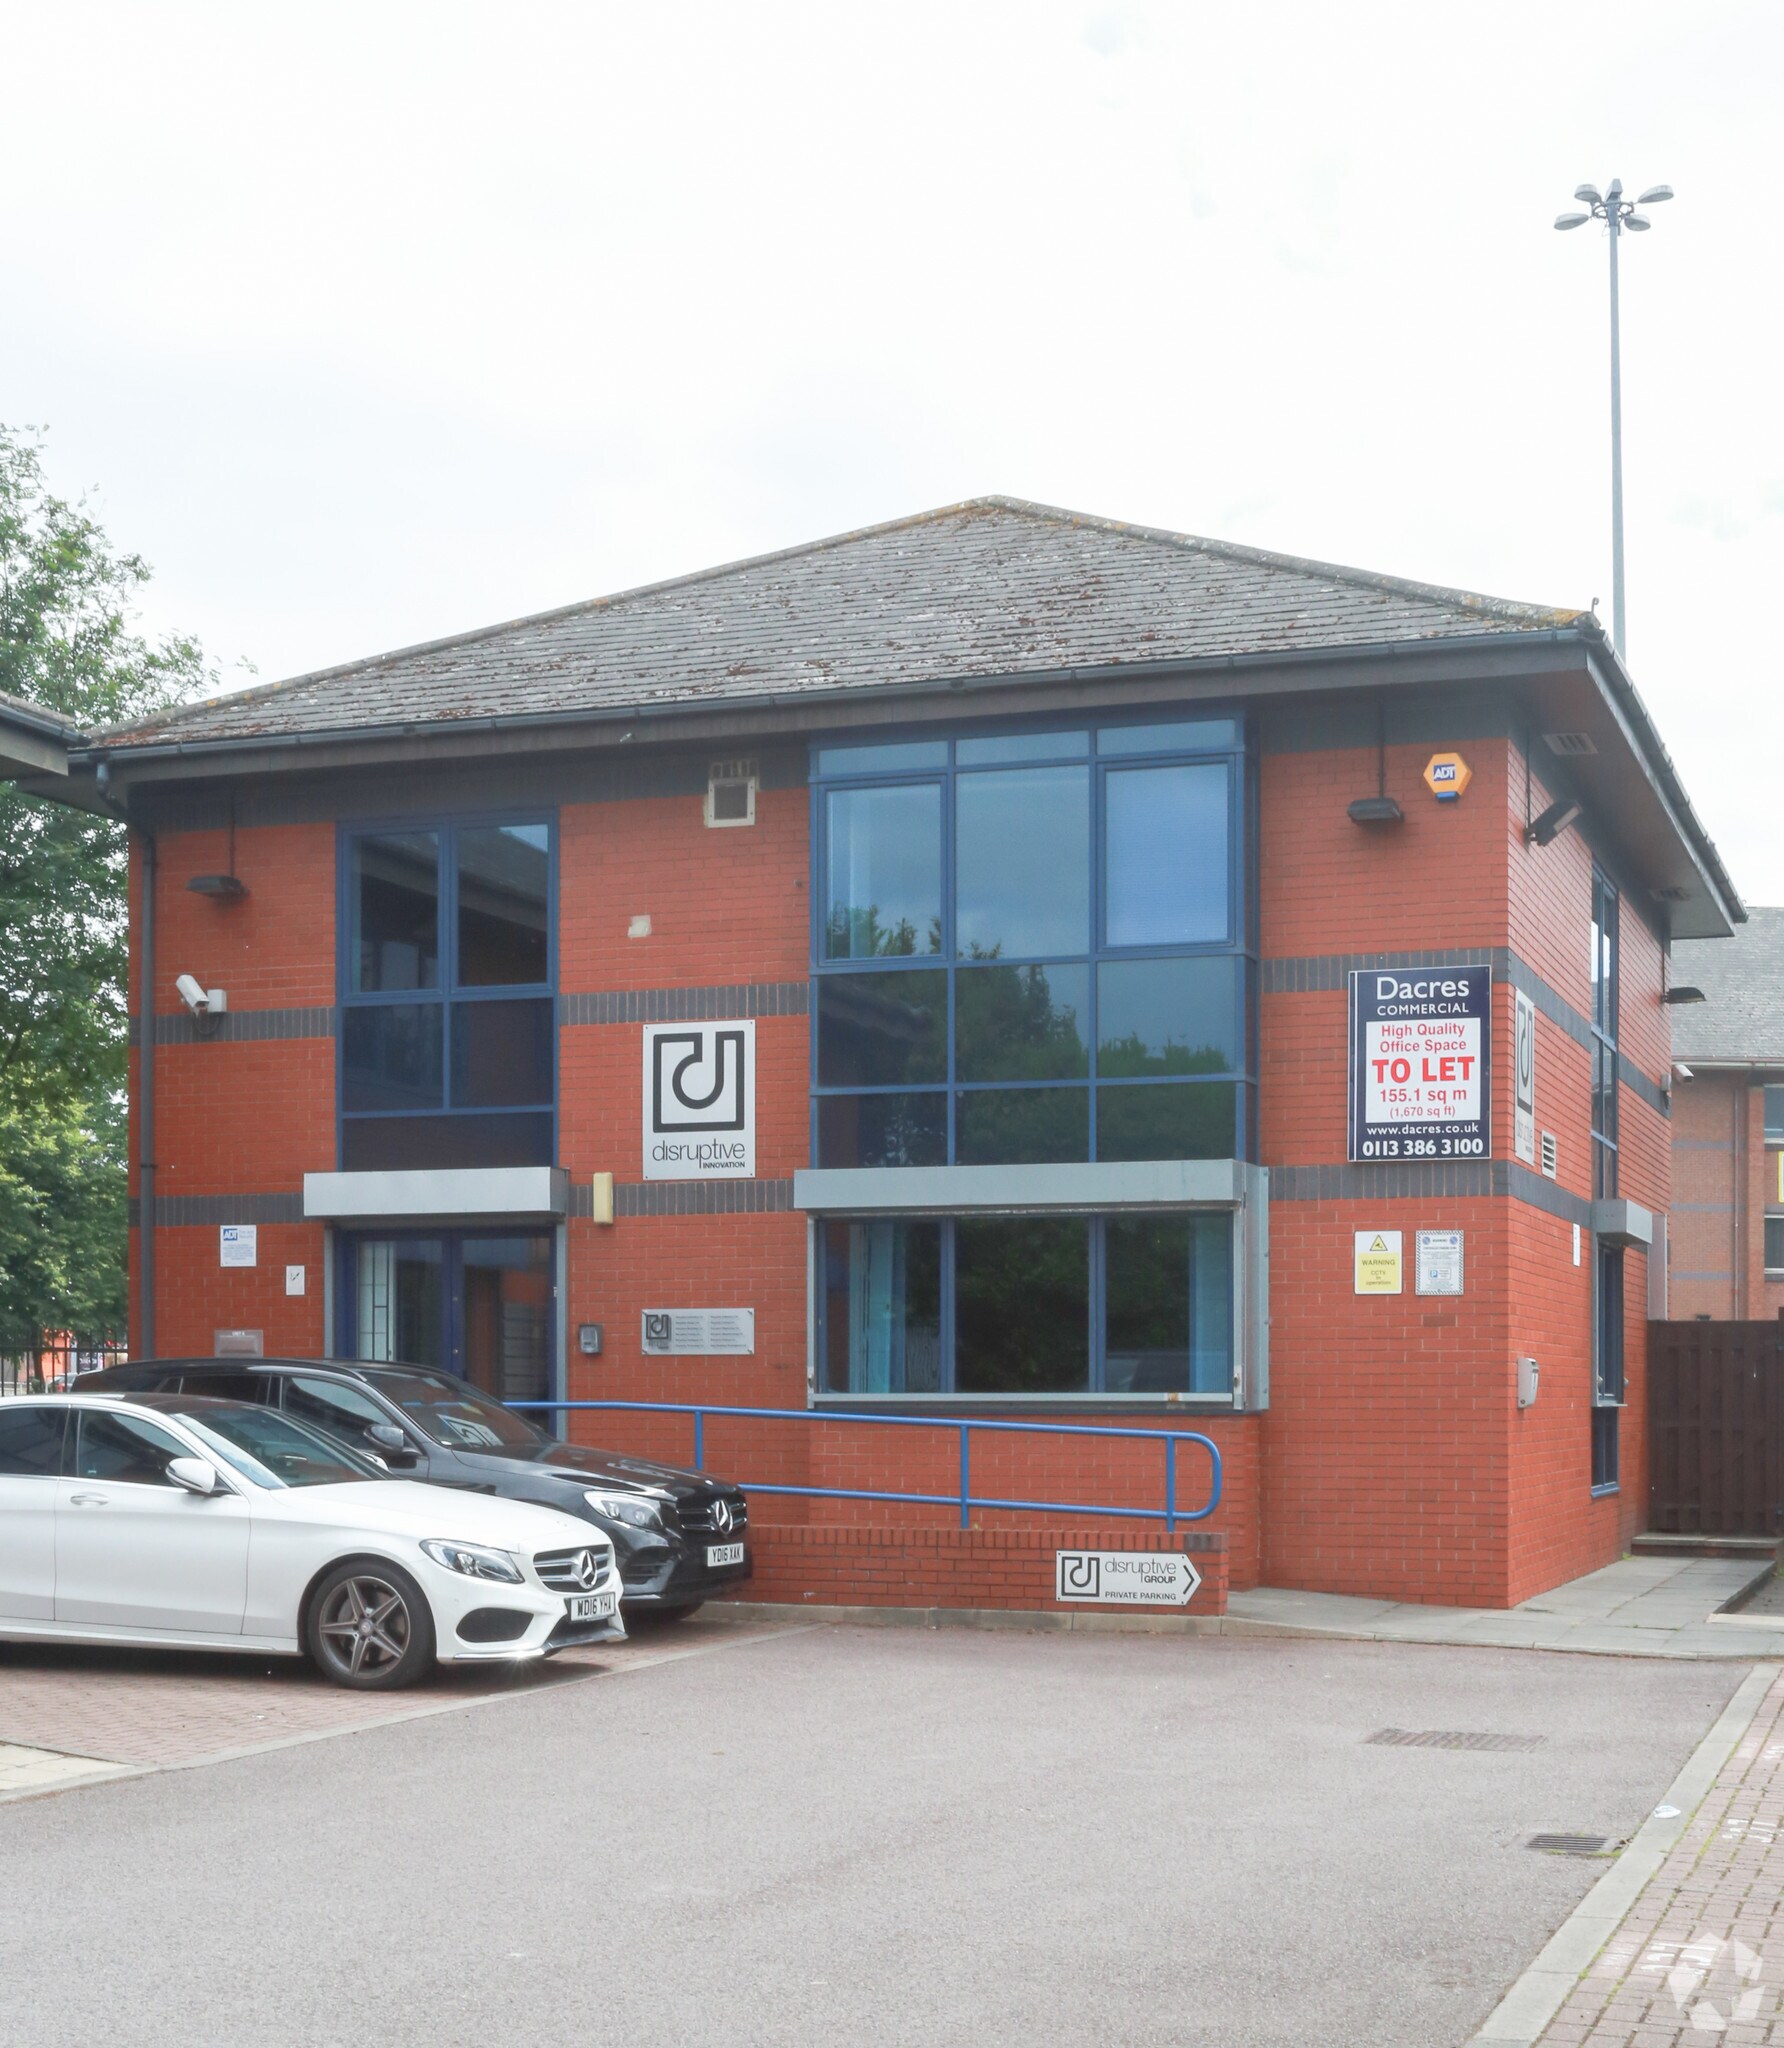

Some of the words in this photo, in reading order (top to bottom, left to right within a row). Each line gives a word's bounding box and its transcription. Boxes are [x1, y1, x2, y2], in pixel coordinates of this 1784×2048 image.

[1434, 766, 1456, 780] ADT
[1376, 976, 1470, 1001] Dacres
[1377, 1002, 1469, 1016] COMMERCIAL
[1381, 1024, 1413, 1039] High
[1417, 1023, 1465, 1037] Quality
[1380, 1040, 1420, 1053] Office
[1424, 1039, 1467, 1054] Space
[1371, 1058, 1411, 1084] TO
[1422, 1056, 1475, 1082] LET
[1380, 1088, 1421, 1103] 155.1
[1427, 1090, 1447, 1105] sq
[1452, 1089, 1467, 1100] m
[1389, 1106, 1424, 1119] (1,670
[1427, 1108, 1440, 1118] sq
[1443, 1105, 1456, 1118] ft)
[1367, 1122, 1479, 1136] www.dacres.co.uk
[652, 1138, 745, 1169] disruptive
[1362, 1140, 1399, 1157] 0113
[1403, 1139, 1437, 1156] 386
[1440, 1138, 1484, 1155] 3100
[703, 1161, 745, 1169] INNOVATION
[224, 1230, 238, 1240] ADT
[712, 1548, 728, 1564] YD16
[729, 1544, 742, 1563] XAK
[1104, 1557, 1177, 1583] disruptive
[1144, 1576, 1176, 1584] GROUP
[1104, 1591, 1138, 1599] PRIVATE
[1140, 1592, 1176, 1600] PARKING
[577, 1598, 597, 1617] WD16
[599, 1594, 612, 1613] YHA
